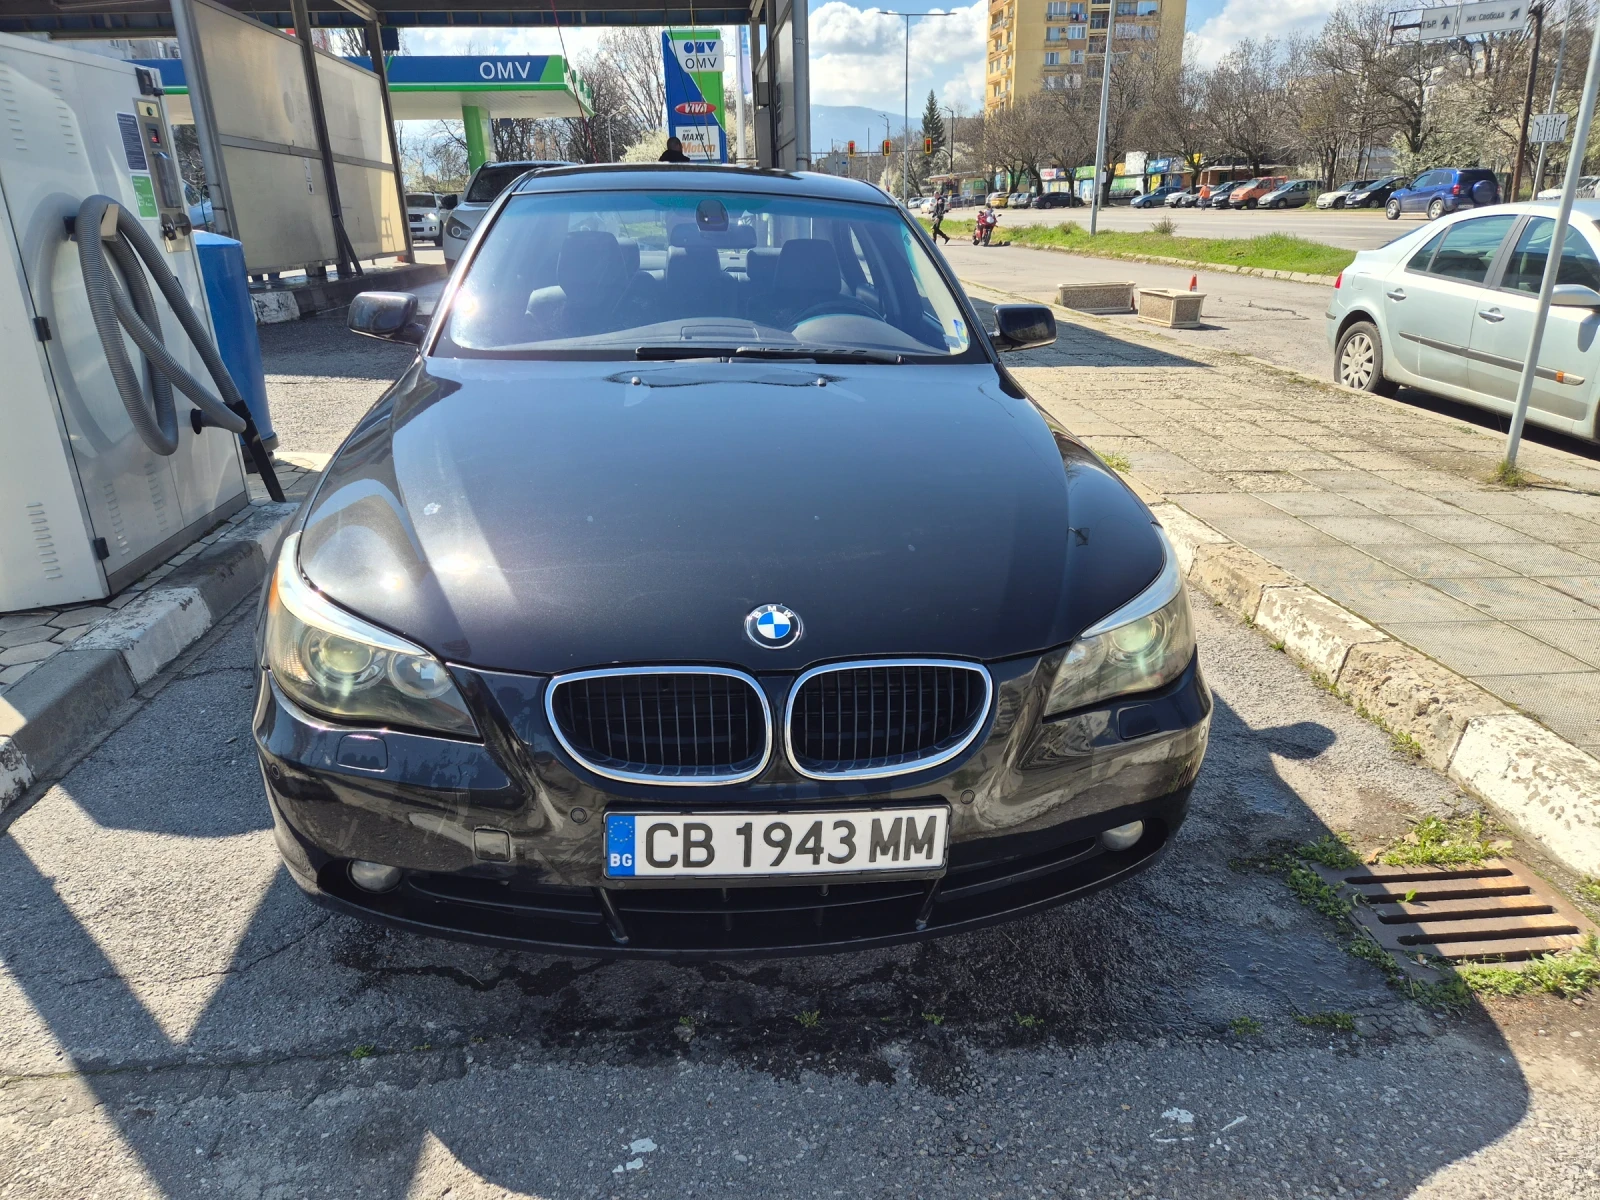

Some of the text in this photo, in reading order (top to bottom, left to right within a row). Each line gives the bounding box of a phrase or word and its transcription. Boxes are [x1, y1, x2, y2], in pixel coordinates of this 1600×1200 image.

[1478, 11, 1505, 20] Свобода
[685, 58, 717, 69] OMV
[479, 61, 531, 79] OMV
[684, 103, 708, 113] VIVA
[682, 133, 704, 141] MAXX
[682, 142, 715, 153] Motion
[752, 605, 793, 618] BMW
[645, 815, 937, 869] CB 1943 MM
[610, 853, 632, 867] BG
